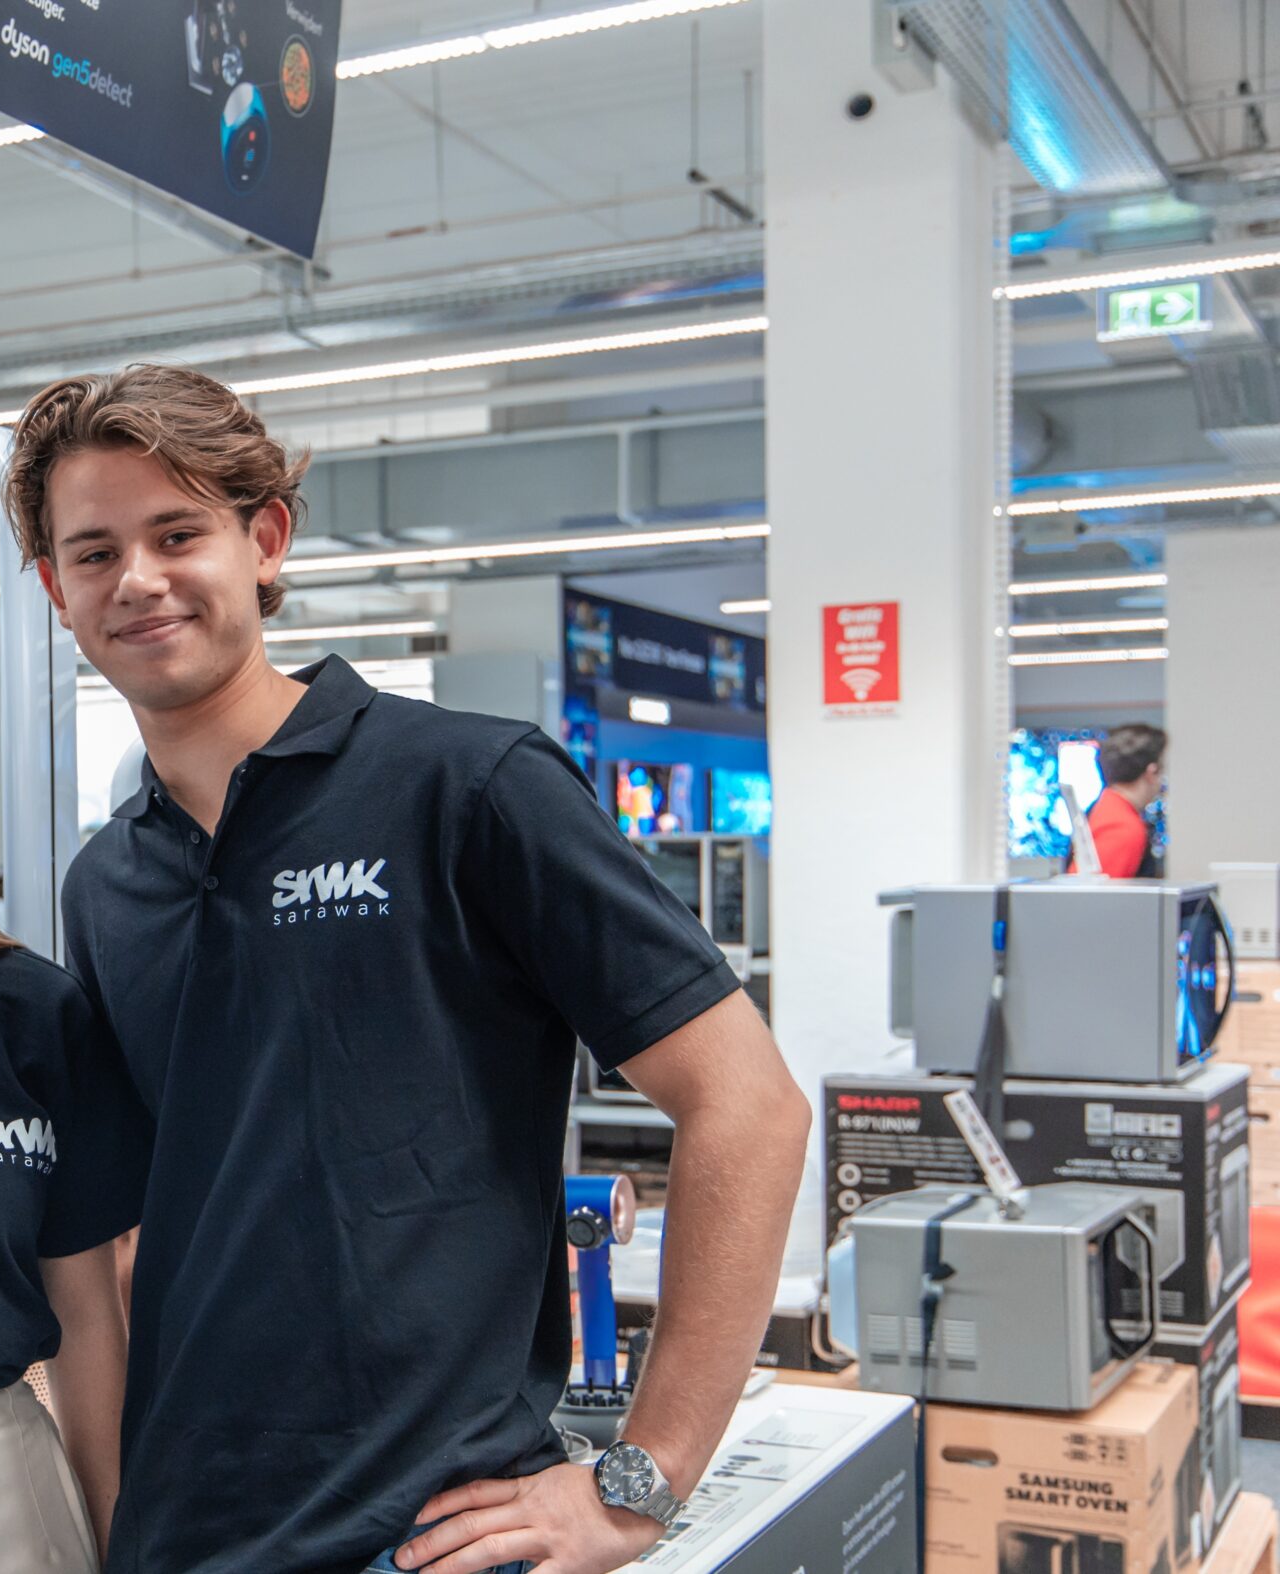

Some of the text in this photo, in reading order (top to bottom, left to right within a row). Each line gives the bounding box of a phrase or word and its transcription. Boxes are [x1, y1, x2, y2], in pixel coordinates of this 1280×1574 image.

[1, 18, 133, 108] dyson gen5detect
[273, 903, 389, 926] sarawak
[1019, 1472, 1113, 1496] SAMSUNG
[1005, 1486, 1128, 1513] SMART OVEN
